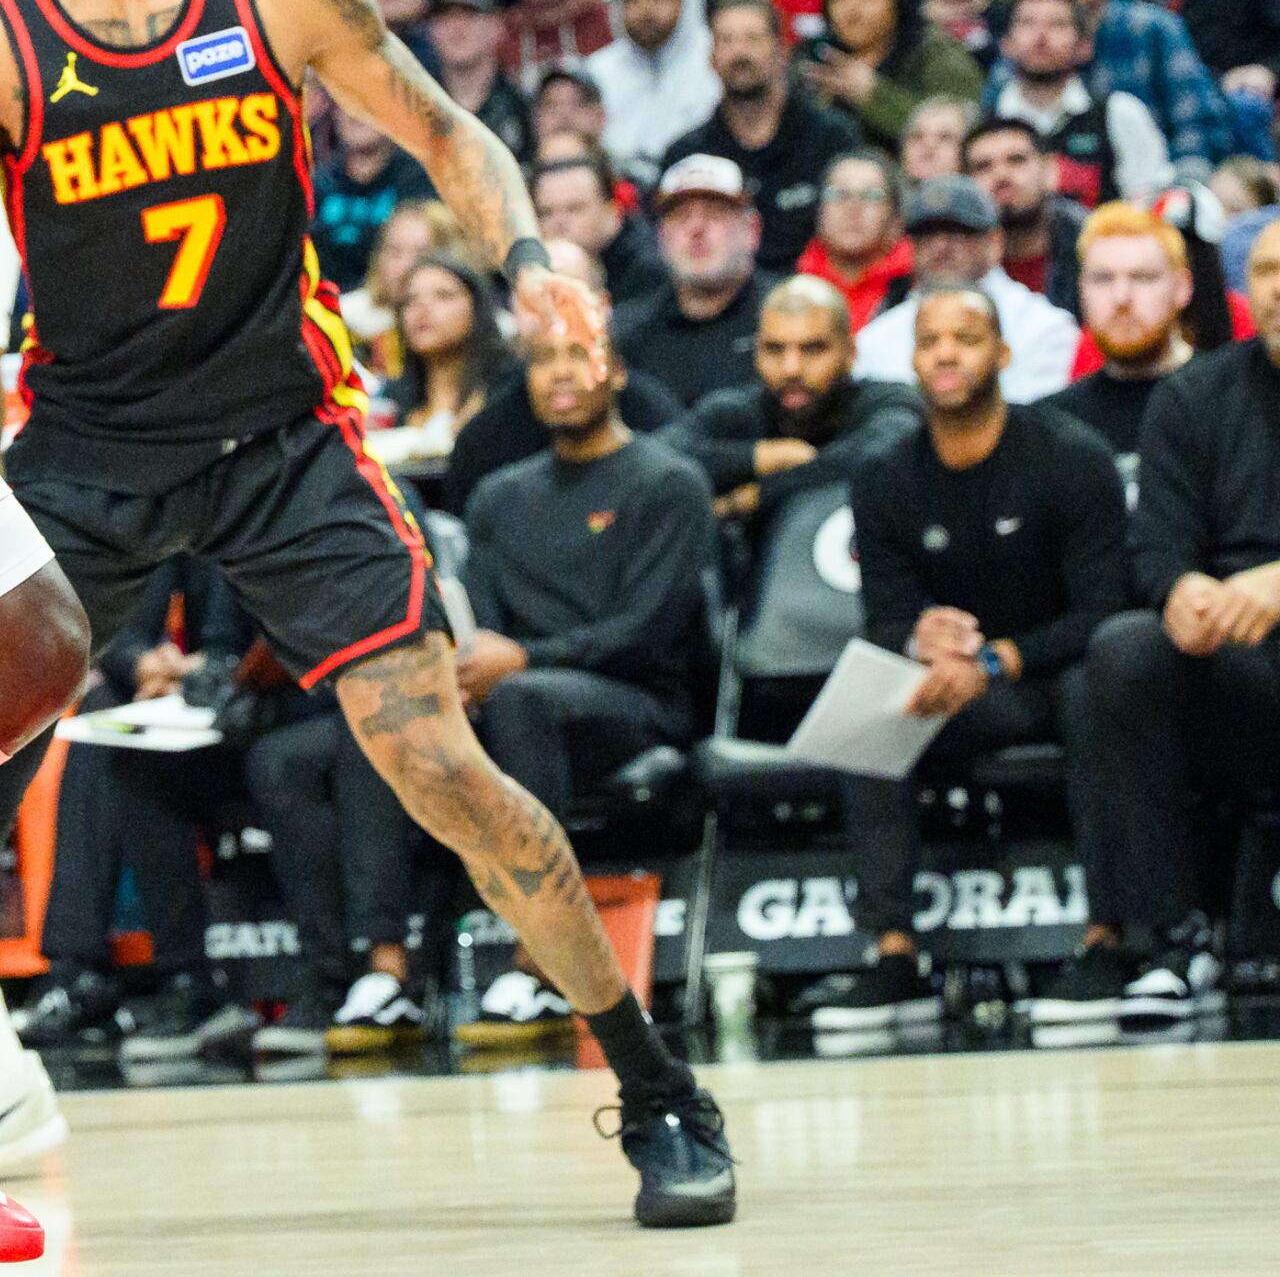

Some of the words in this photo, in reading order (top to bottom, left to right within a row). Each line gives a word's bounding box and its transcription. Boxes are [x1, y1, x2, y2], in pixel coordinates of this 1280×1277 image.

[185, 39, 244, 76] paze
[42, 93, 282, 205] HAWKS
[141, 192, 228, 310] 7
